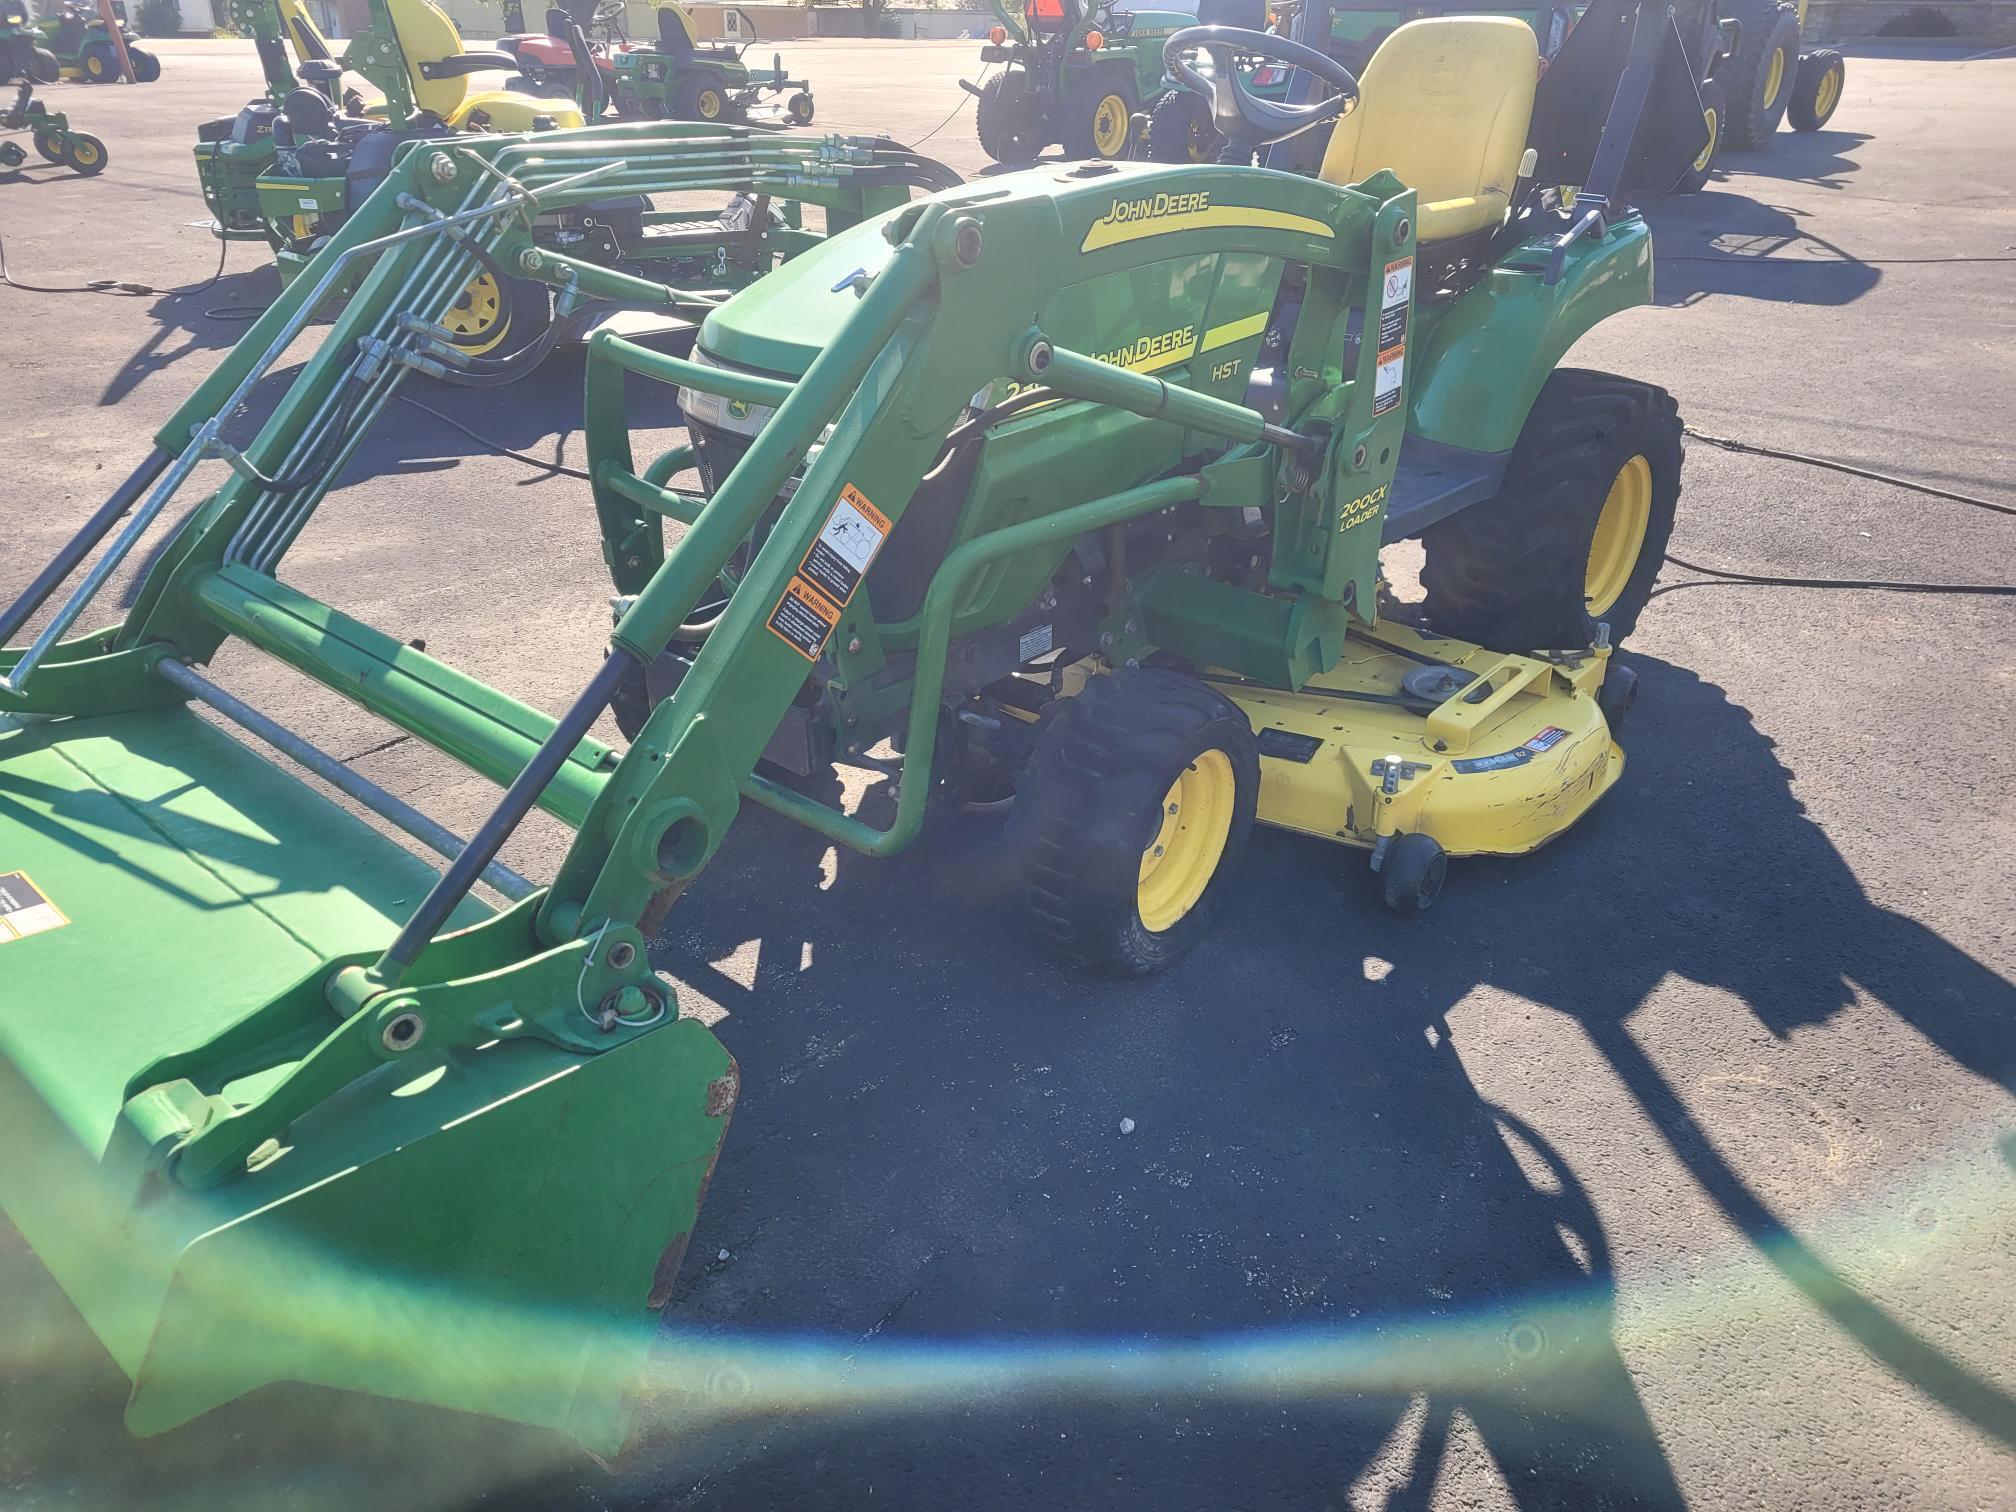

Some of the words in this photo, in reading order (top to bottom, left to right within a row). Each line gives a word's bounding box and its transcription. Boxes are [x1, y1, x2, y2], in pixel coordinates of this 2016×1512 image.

[1103, 198, 1153, 225] JOHN
[1152, 191, 1210, 217] DEERE
[1134, 324, 1194, 362] DEERE
[1211, 359, 1242, 382] HST
[855, 496, 886, 529] WARNING
[1340, 483, 1388, 519] 200CX
[1340, 504, 1380, 533] LOADER
[803, 591, 834, 620] WARNING
